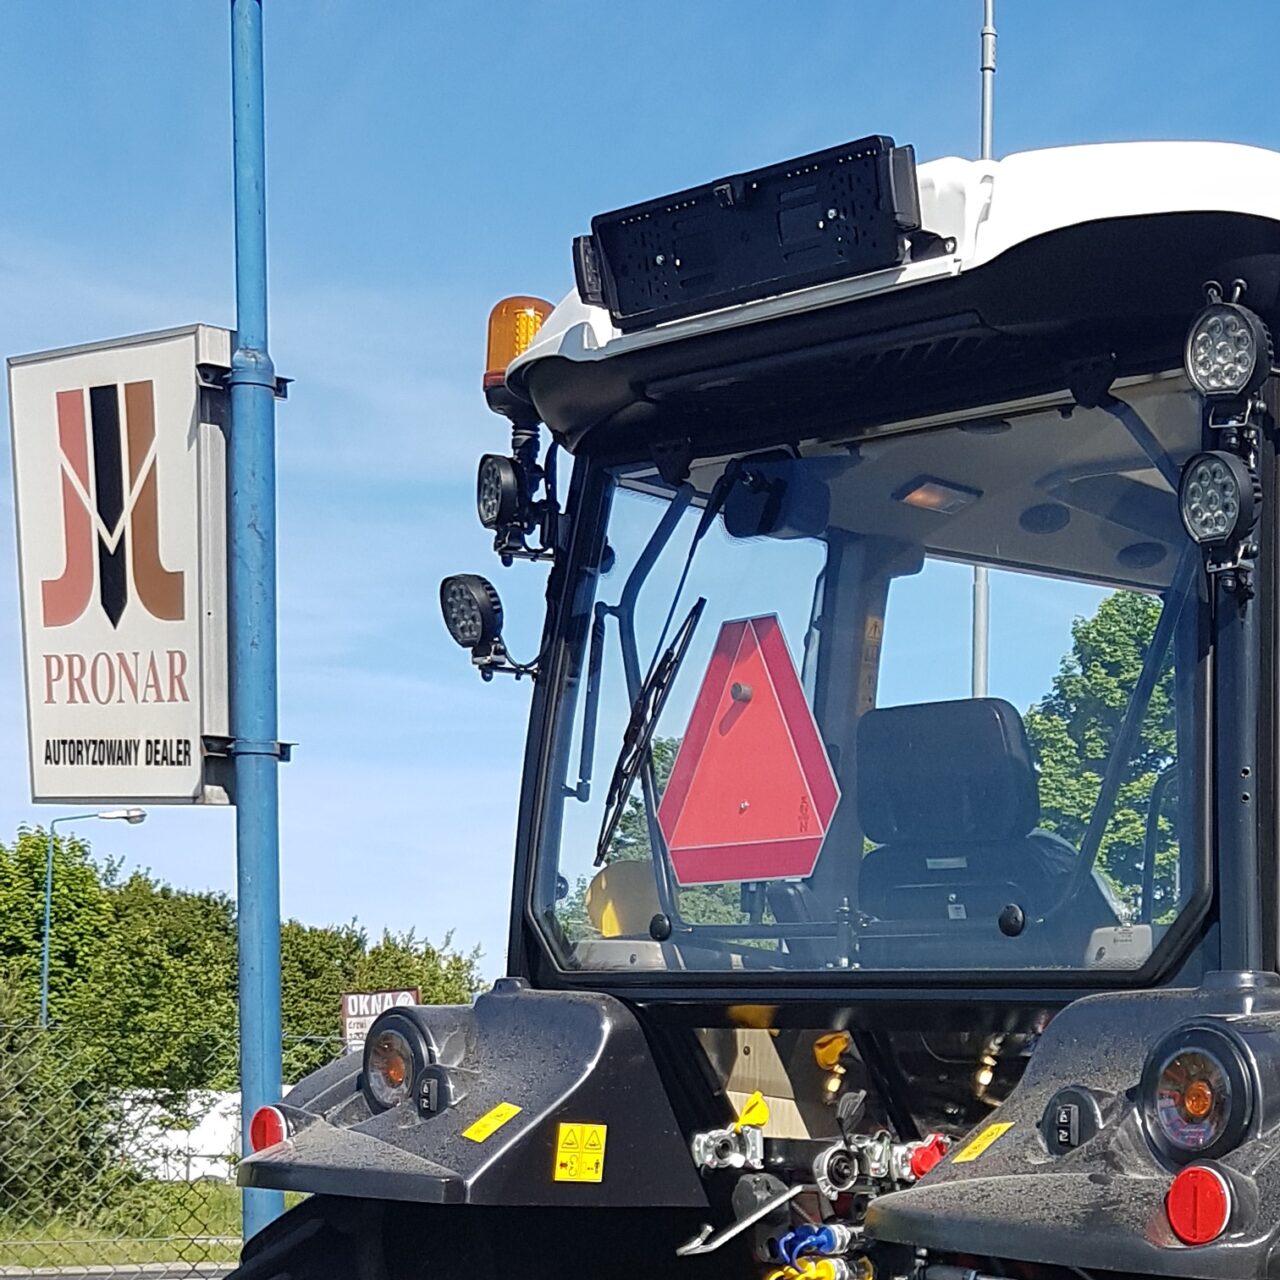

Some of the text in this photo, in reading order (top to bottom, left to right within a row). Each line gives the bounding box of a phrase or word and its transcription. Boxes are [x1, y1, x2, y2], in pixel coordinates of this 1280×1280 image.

[43, 650, 190, 705] PRONAR
[44, 738, 192, 767] AUTORYZOWANY DEALER
[347, 992, 394, 1016] OKNA
